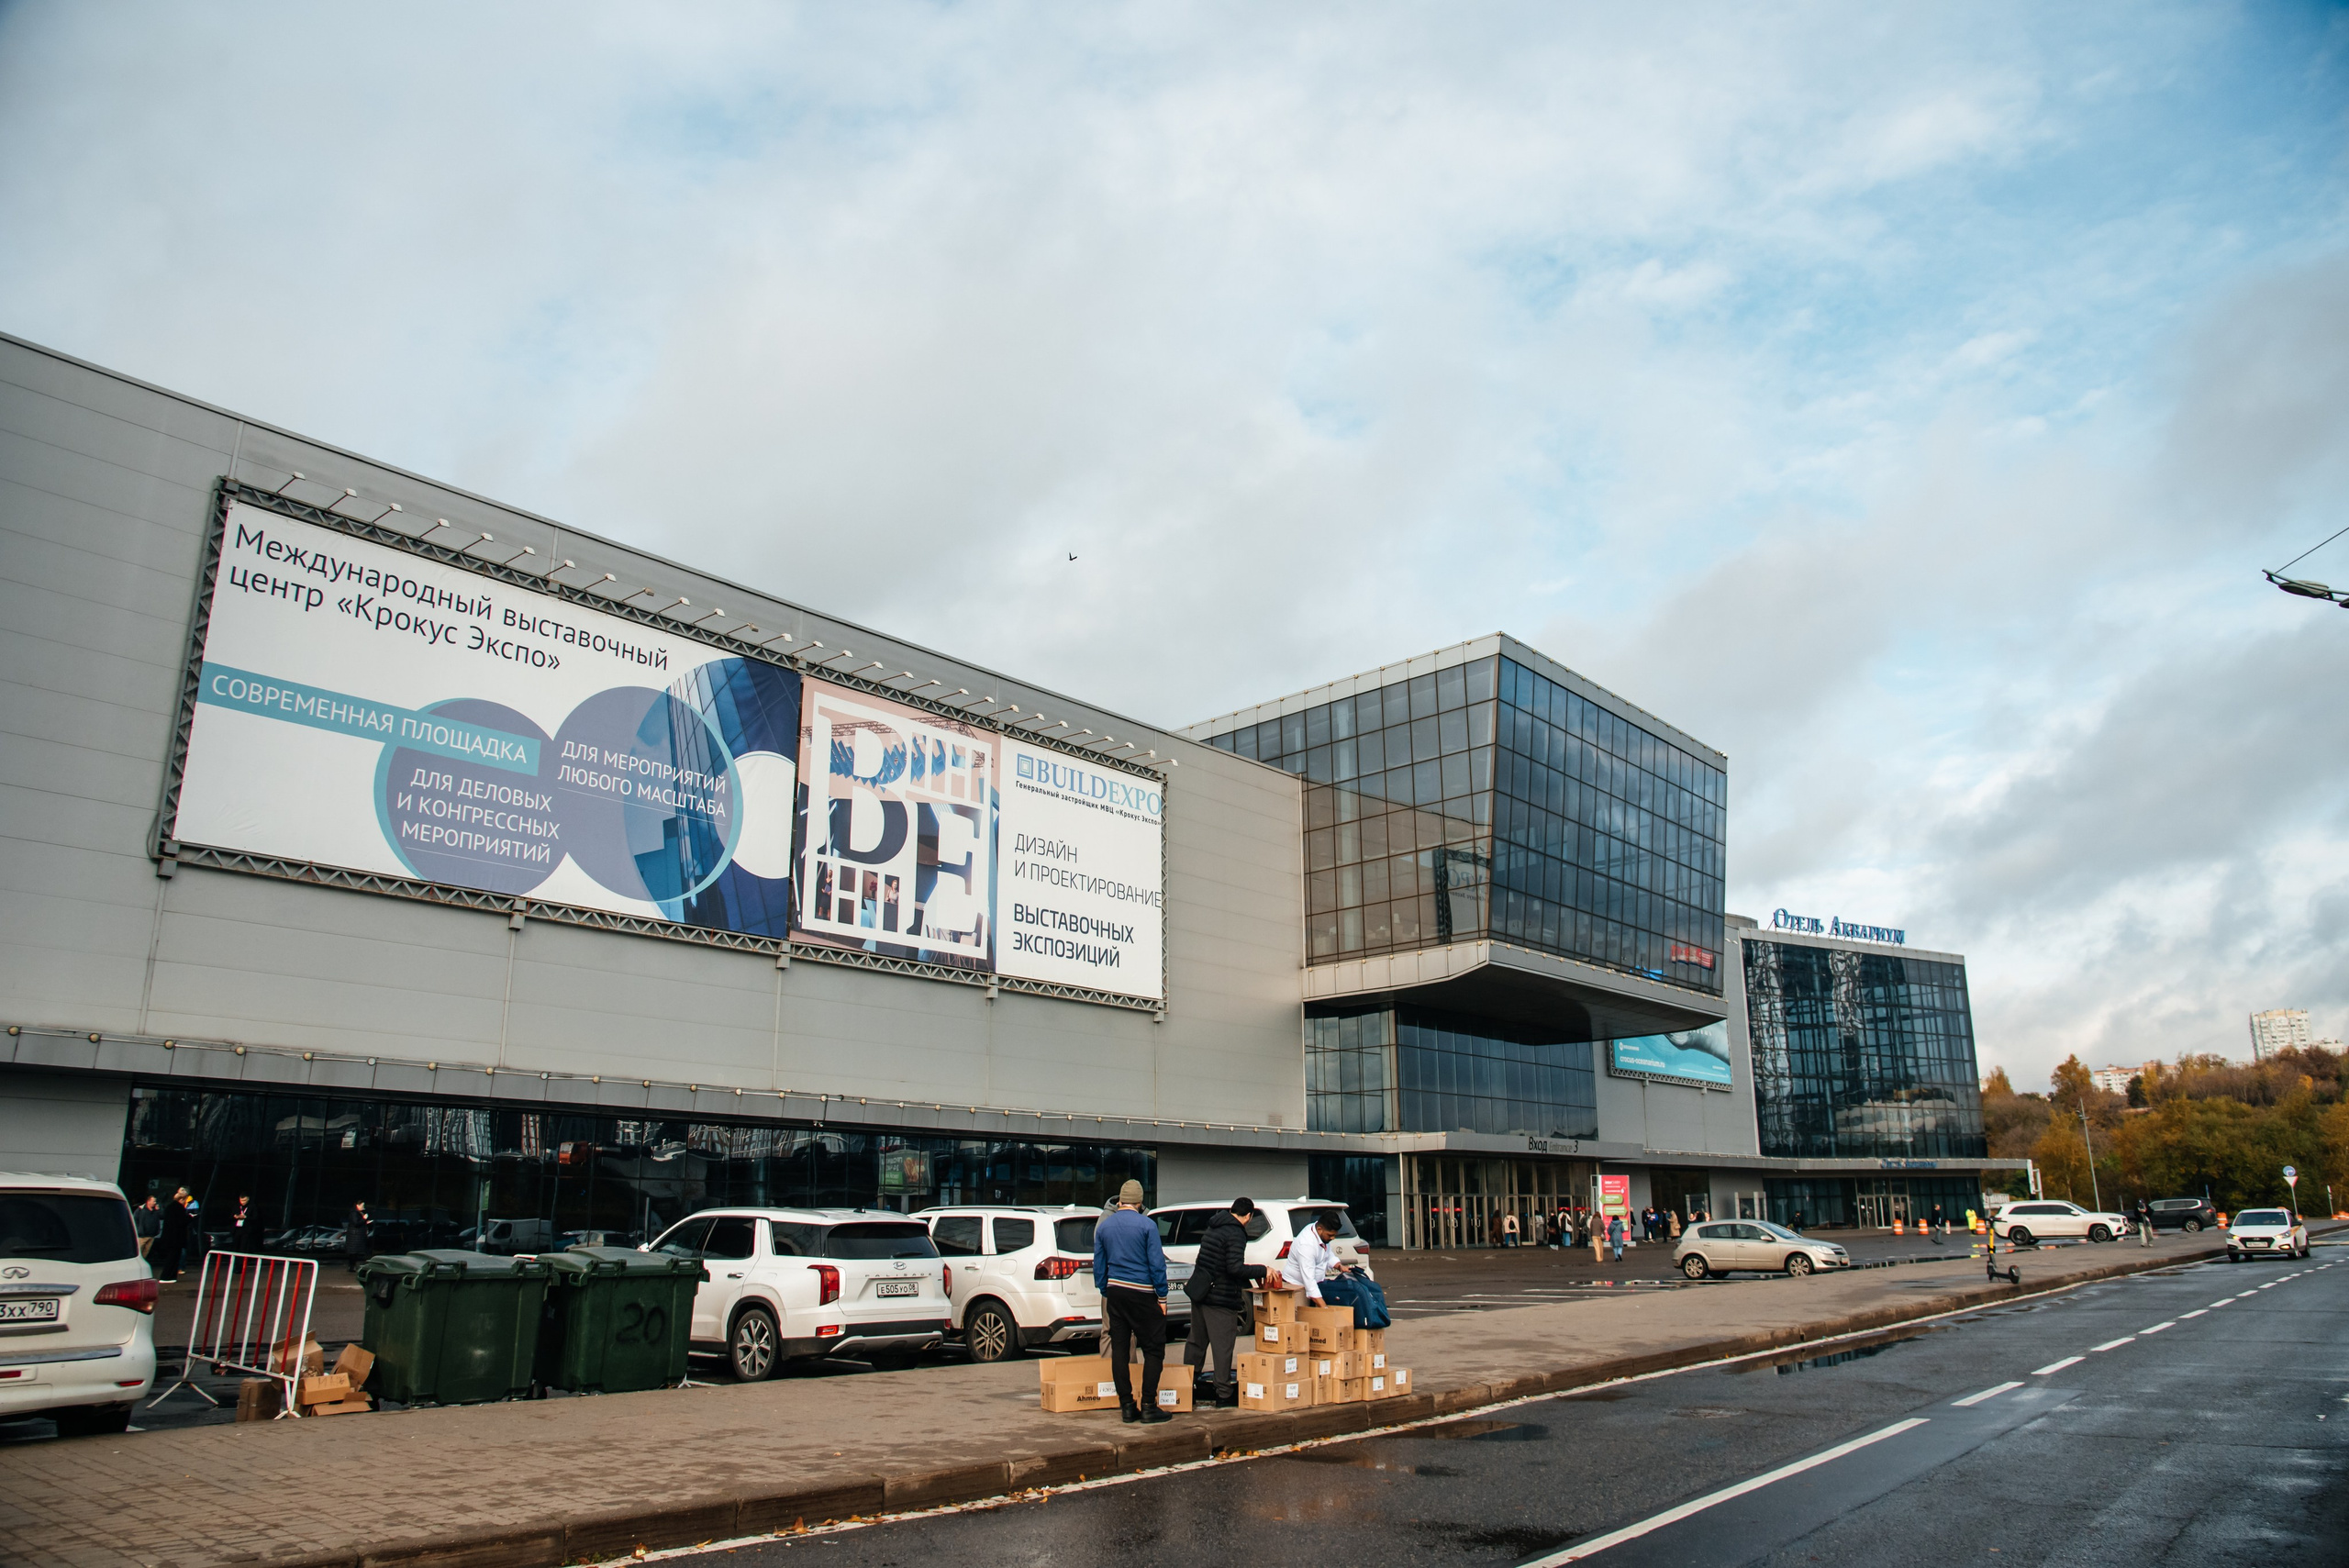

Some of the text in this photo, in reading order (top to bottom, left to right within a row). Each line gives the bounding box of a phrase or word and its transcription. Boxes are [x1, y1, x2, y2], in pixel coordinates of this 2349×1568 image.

[229, 565, 561, 670] центр «Крокус Экспо»
[236, 523, 668, 671] Международный выставочный
[212, 674, 528, 764] СОВРЕМЕННАЯ ПЛОЩАДКА
[410, 768, 552, 813] ДЛЯ ДЕЛОВЫХ
[557, 764, 726, 817] ЛЮБОГО МАСШТАБА
[561, 740, 726, 795] ДЛЯ МЕРОПРИЯТИЙ
[1036, 758, 1162, 816] BUILDEXPO
[396, 792, 561, 840] И КОНГРЕССНЫХ
[1016, 780, 1162, 826] Генеральный застройщик МВЦ «Крокус Экспо»
[402, 820, 551, 864] МЕРОПРИЯТИЙ
[1014, 833, 1077, 863] ДИЗАЙН
[1015, 860, 1162, 908] И ПРОЕКТИРОВАНИЕ
[1013, 903, 1134, 944] ВЫСТАВОЧНЫХ
[1012, 931, 1120, 968] ЭКСПОЗИЦИЙ
[1529, 1137, 1578, 1153] Вход Entrance 3
[30, 1301, 53, 1313] 790
[616, 1302, 666, 1345] 20
